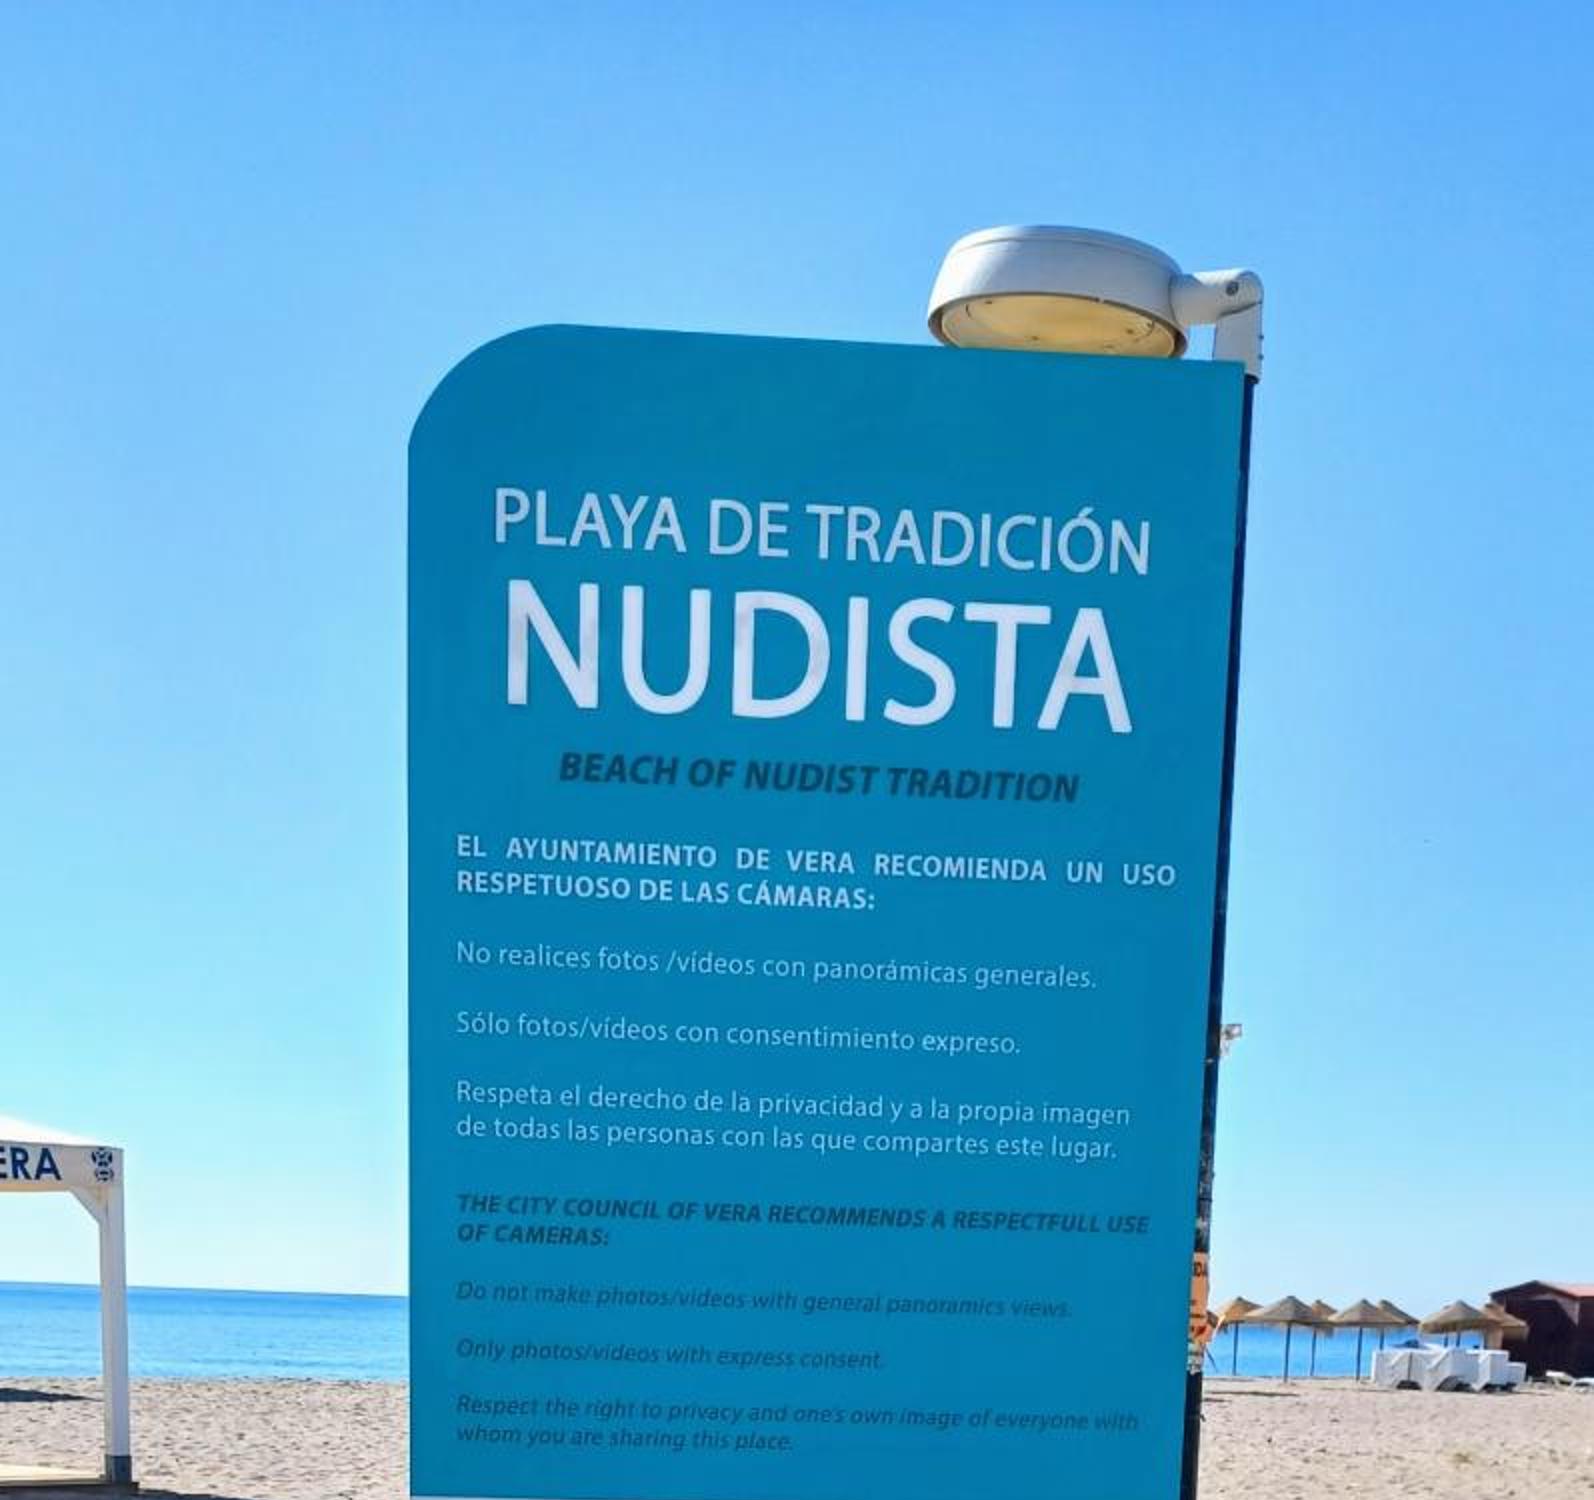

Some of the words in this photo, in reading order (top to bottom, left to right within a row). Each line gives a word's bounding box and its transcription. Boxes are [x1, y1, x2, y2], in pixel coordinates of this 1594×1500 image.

[496, 488, 686, 552] PLAYA
[710, 499, 789, 557] DE
[806, 505, 1149, 575] TRADICIÓN
[508, 580, 1132, 732] NUDISTA
[560, 752, 679, 784] BEACH
[688, 758, 736, 788] OF
[744, 761, 880, 794] NUDIST
[888, 768, 1079, 803] TRADITION
[458, 835, 486, 856] EL
[507, 838, 716, 867] AYUNTAMIENTO
[737, 848, 769, 870] DE
[787, 850, 854, 874] VERA
[875, 854, 1046, 880] RECOMIENDA
[1067, 861, 1102, 883] UN
[1124, 864, 1175, 885] USO
[458, 871, 630, 898] RESPETUOSO
[640, 879, 672, 900] DE
[682, 881, 729, 903] LAS
[738, 880, 874, 909] CÁMARAS:
[458, 941, 490, 963] No
[500, 944, 590, 968] realices
[598, 946, 658, 971] fotos
[666, 951, 755, 974] /vídeos
[763, 960, 804, 976] con
[814, 960, 966, 982] panorámicas
[975, 965, 1096, 989] generales.
[457, 1011, 509, 1034] Sólo
[518, 1013, 668, 1040] fotos/vídeos
[676, 1026, 718, 1042] con
[727, 1026, 914, 1050] consentimiento
[922, 1035, 1020, 1056] expreso.
[458, 1081, 551, 1108] Respeta
[560, 1084, 580, 1106] el
[589, 1085, 686, 1110] derecho
[694, 1090, 723, 1111] de
[732, 1091, 750, 1112] la
[760, 1094, 882, 1118] privacidad
[891, 1103, 902, 1123] y
[910, 1103, 922, 1118] a
[932, 1098, 949, 1119] la
[958, 1102, 1033, 1126] propia
[1043, 1103, 1129, 1129] imagen
[457, 1114, 486, 1136] de
[494, 1117, 560, 1139] todas
[569, 1119, 599, 1140] las
[608, 1126, 714, 1146] personas
[722, 1130, 764, 1146] con
[774, 1126, 803, 1148] las
[812, 1134, 855, 1155] que
[864, 1135, 988, 1157] compartes
[997, 1137, 1043, 1155] este
[1052, 1136, 1116, 1162] lugar.
[458, 1194, 500, 1213] THE
[506, 1196, 558, 1215] CITY
[564, 1199, 660, 1219] COUNCIL
[668, 1202, 699, 1220] OF
[704, 1203, 761, 1222] VERA
[768, 1205, 926, 1227] RECOMMENDS
[931, 1210, 945, 1229] A
[953, 1211, 1100, 1232] RESPECTFULL
[1107, 1216, 1150, 1234] USE
[458, 1224, 488, 1242] OF
[495, 1224, 608, 1246] CAMERAS:
[456, 1280, 486, 1300] Do
[493, 1285, 528, 1301] not
[535, 1285, 591, 1304] make
[596, 1285, 746, 1308] photos/videos
[753, 1292, 797, 1309] with
[803, 1296, 880, 1315] general
[886, 1299, 1004, 1315] panoramics
[457, 1338, 505, 1362] Only
[511, 1341, 659, 1362] photos/videos
[667, 1346, 711, 1364] with
[717, 1351, 794, 1369] express
[456, 1394, 538, 1417] Respect
[546, 1397, 579, 1417] the
[585, 1400, 634, 1422] right
[642, 1402, 662, 1420] to
[667, 1406, 744, 1424] privacy
[748, 1406, 788, 1422] and
[850, 1410, 893, 1424] own
[899, 1408, 963, 1431] image
[968, 1408, 992, 1427] of
[995, 1414, 1088, 1432] everyone
[1095, 1413, 1138, 1432] with
[457, 1423, 521, 1443] whom
[528, 1430, 567, 1448] you
[570, 1431, 603, 1445] are
[610, 1428, 685, 1452] sharing
[693, 1429, 730, 1449] this
